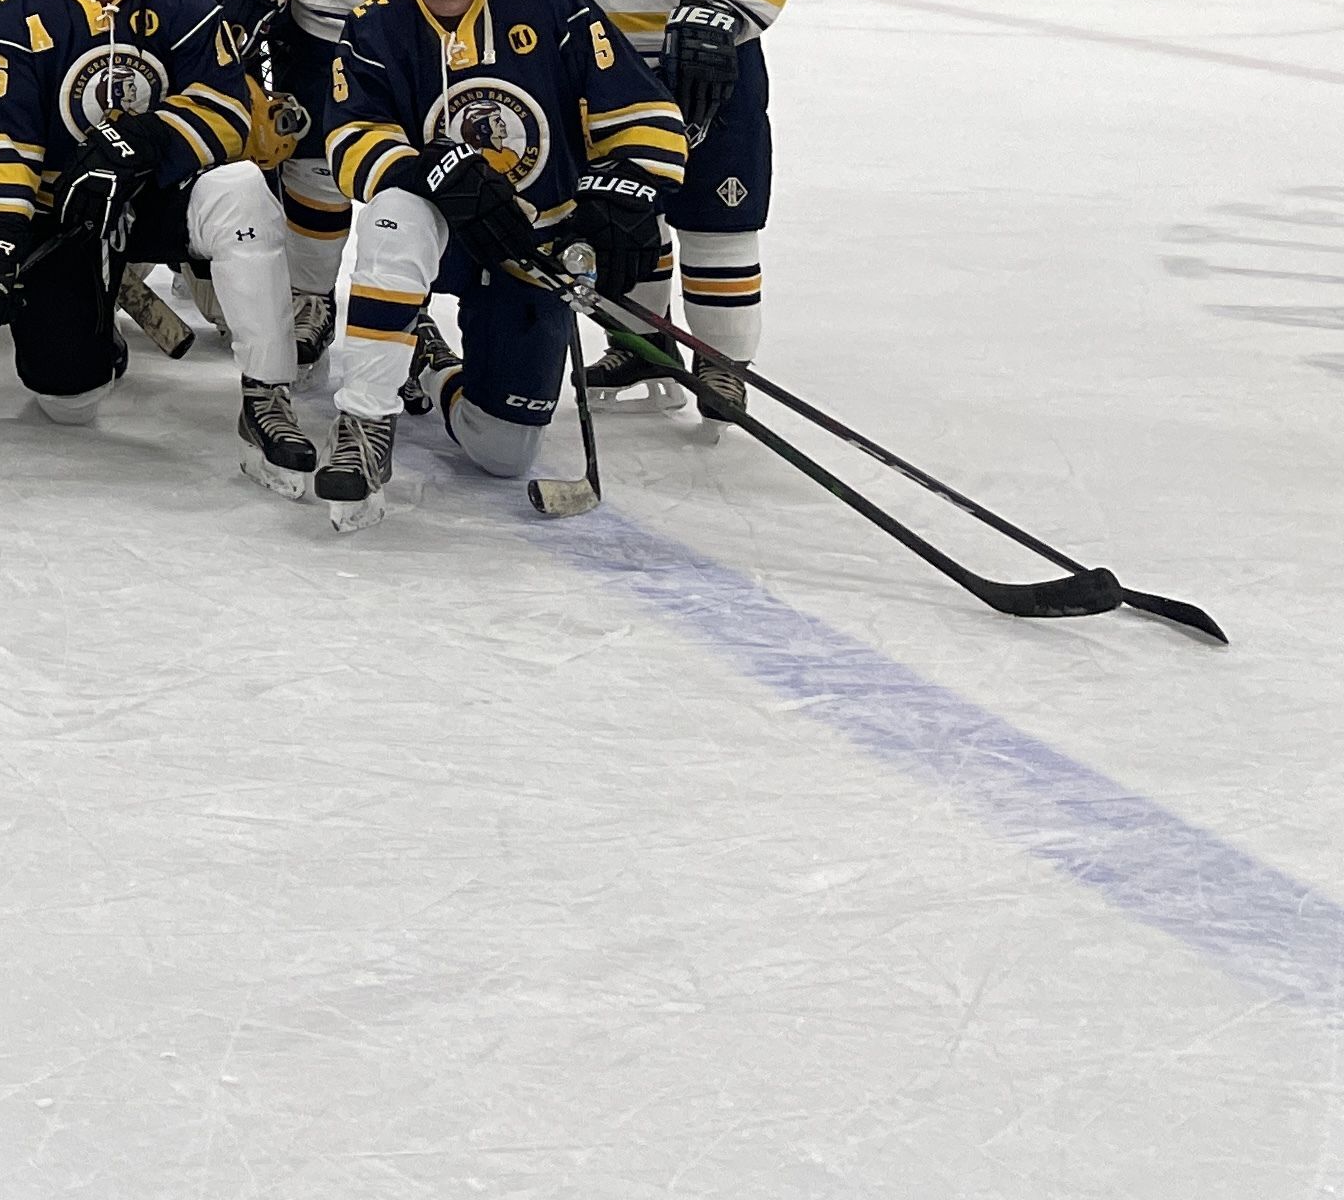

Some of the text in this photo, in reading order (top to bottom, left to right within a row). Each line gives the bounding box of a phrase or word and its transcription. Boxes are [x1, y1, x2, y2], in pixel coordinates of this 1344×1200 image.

[511, 30, 532, 48] KJ
[589, 20, 615, 70] 5
[331, 56, 350, 103] 5
[488, 90, 526, 119] RAPIDS
